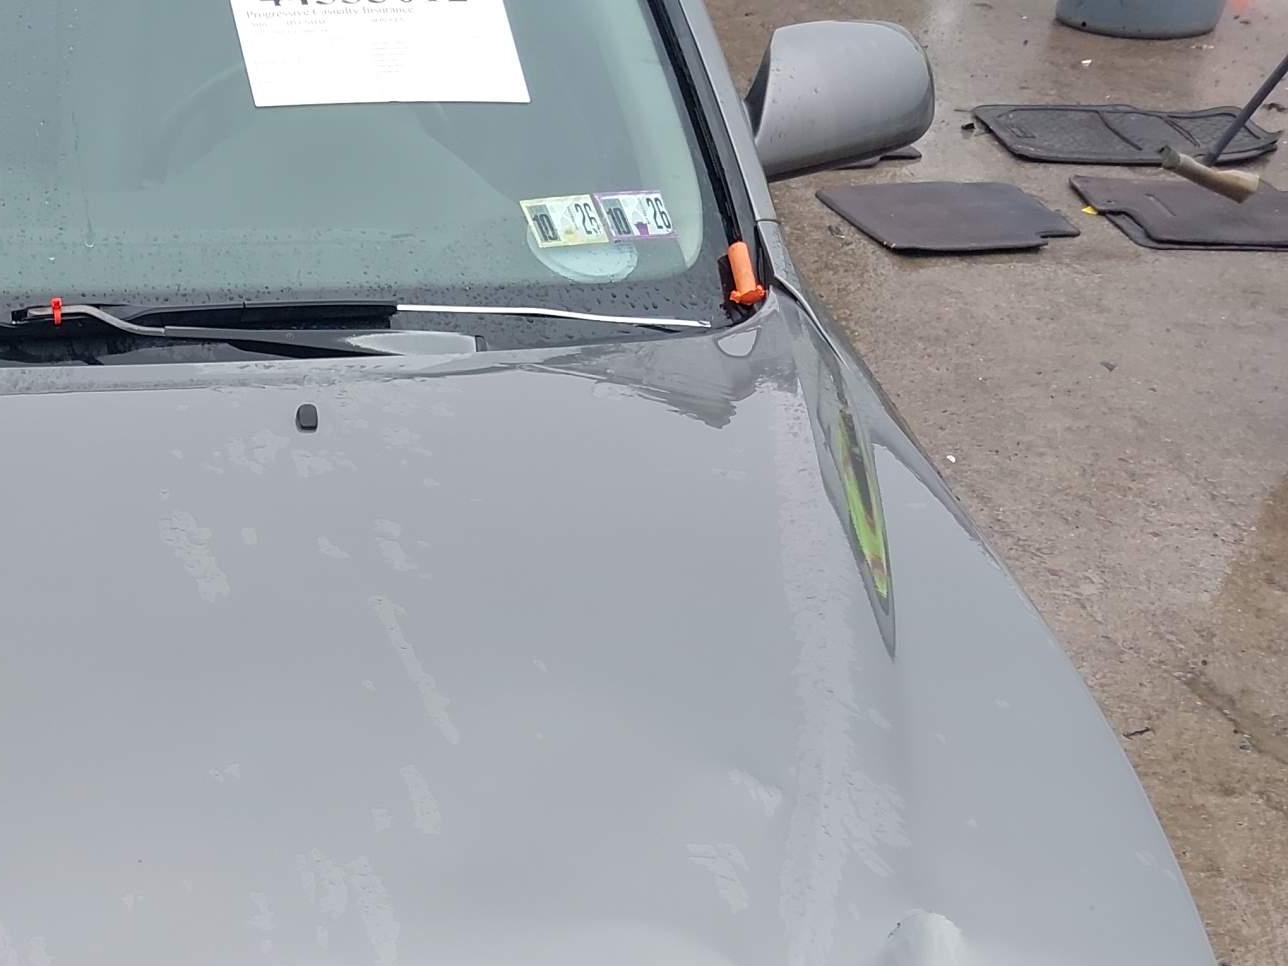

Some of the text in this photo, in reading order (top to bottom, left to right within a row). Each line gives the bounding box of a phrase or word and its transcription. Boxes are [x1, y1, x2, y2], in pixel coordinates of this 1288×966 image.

[532, 213, 558, 242] 10
[606, 197, 672, 235] 10 26
